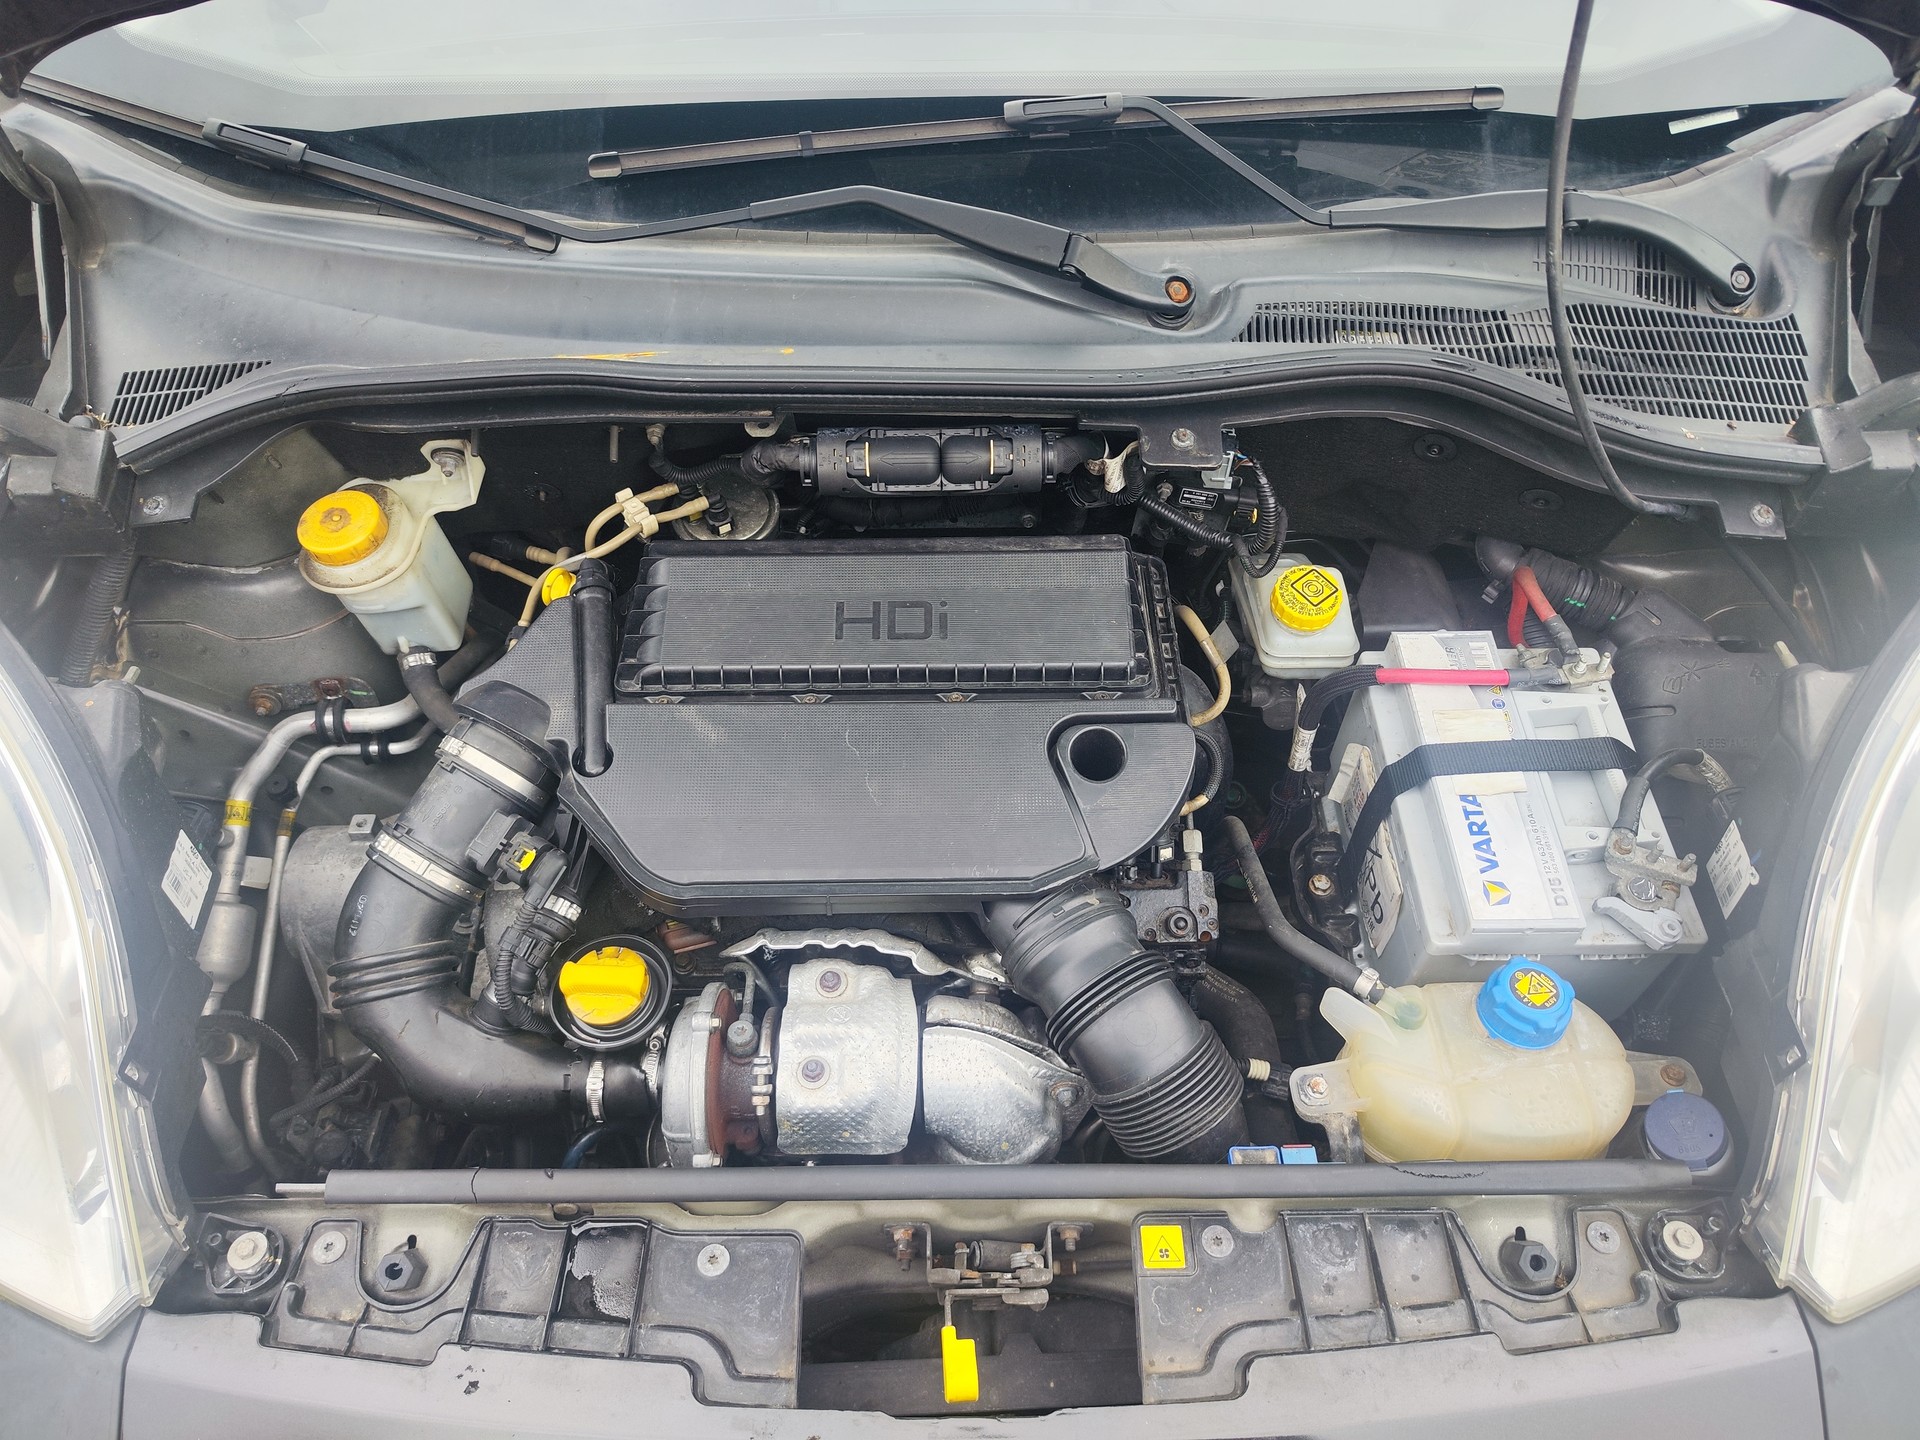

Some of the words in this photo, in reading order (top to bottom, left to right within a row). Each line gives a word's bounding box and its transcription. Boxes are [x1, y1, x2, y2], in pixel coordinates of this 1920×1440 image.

[835, 599, 949, 641] HDi
[1459, 794, 1499, 875] VARTA
[1549, 878, 1568, 906] D15
